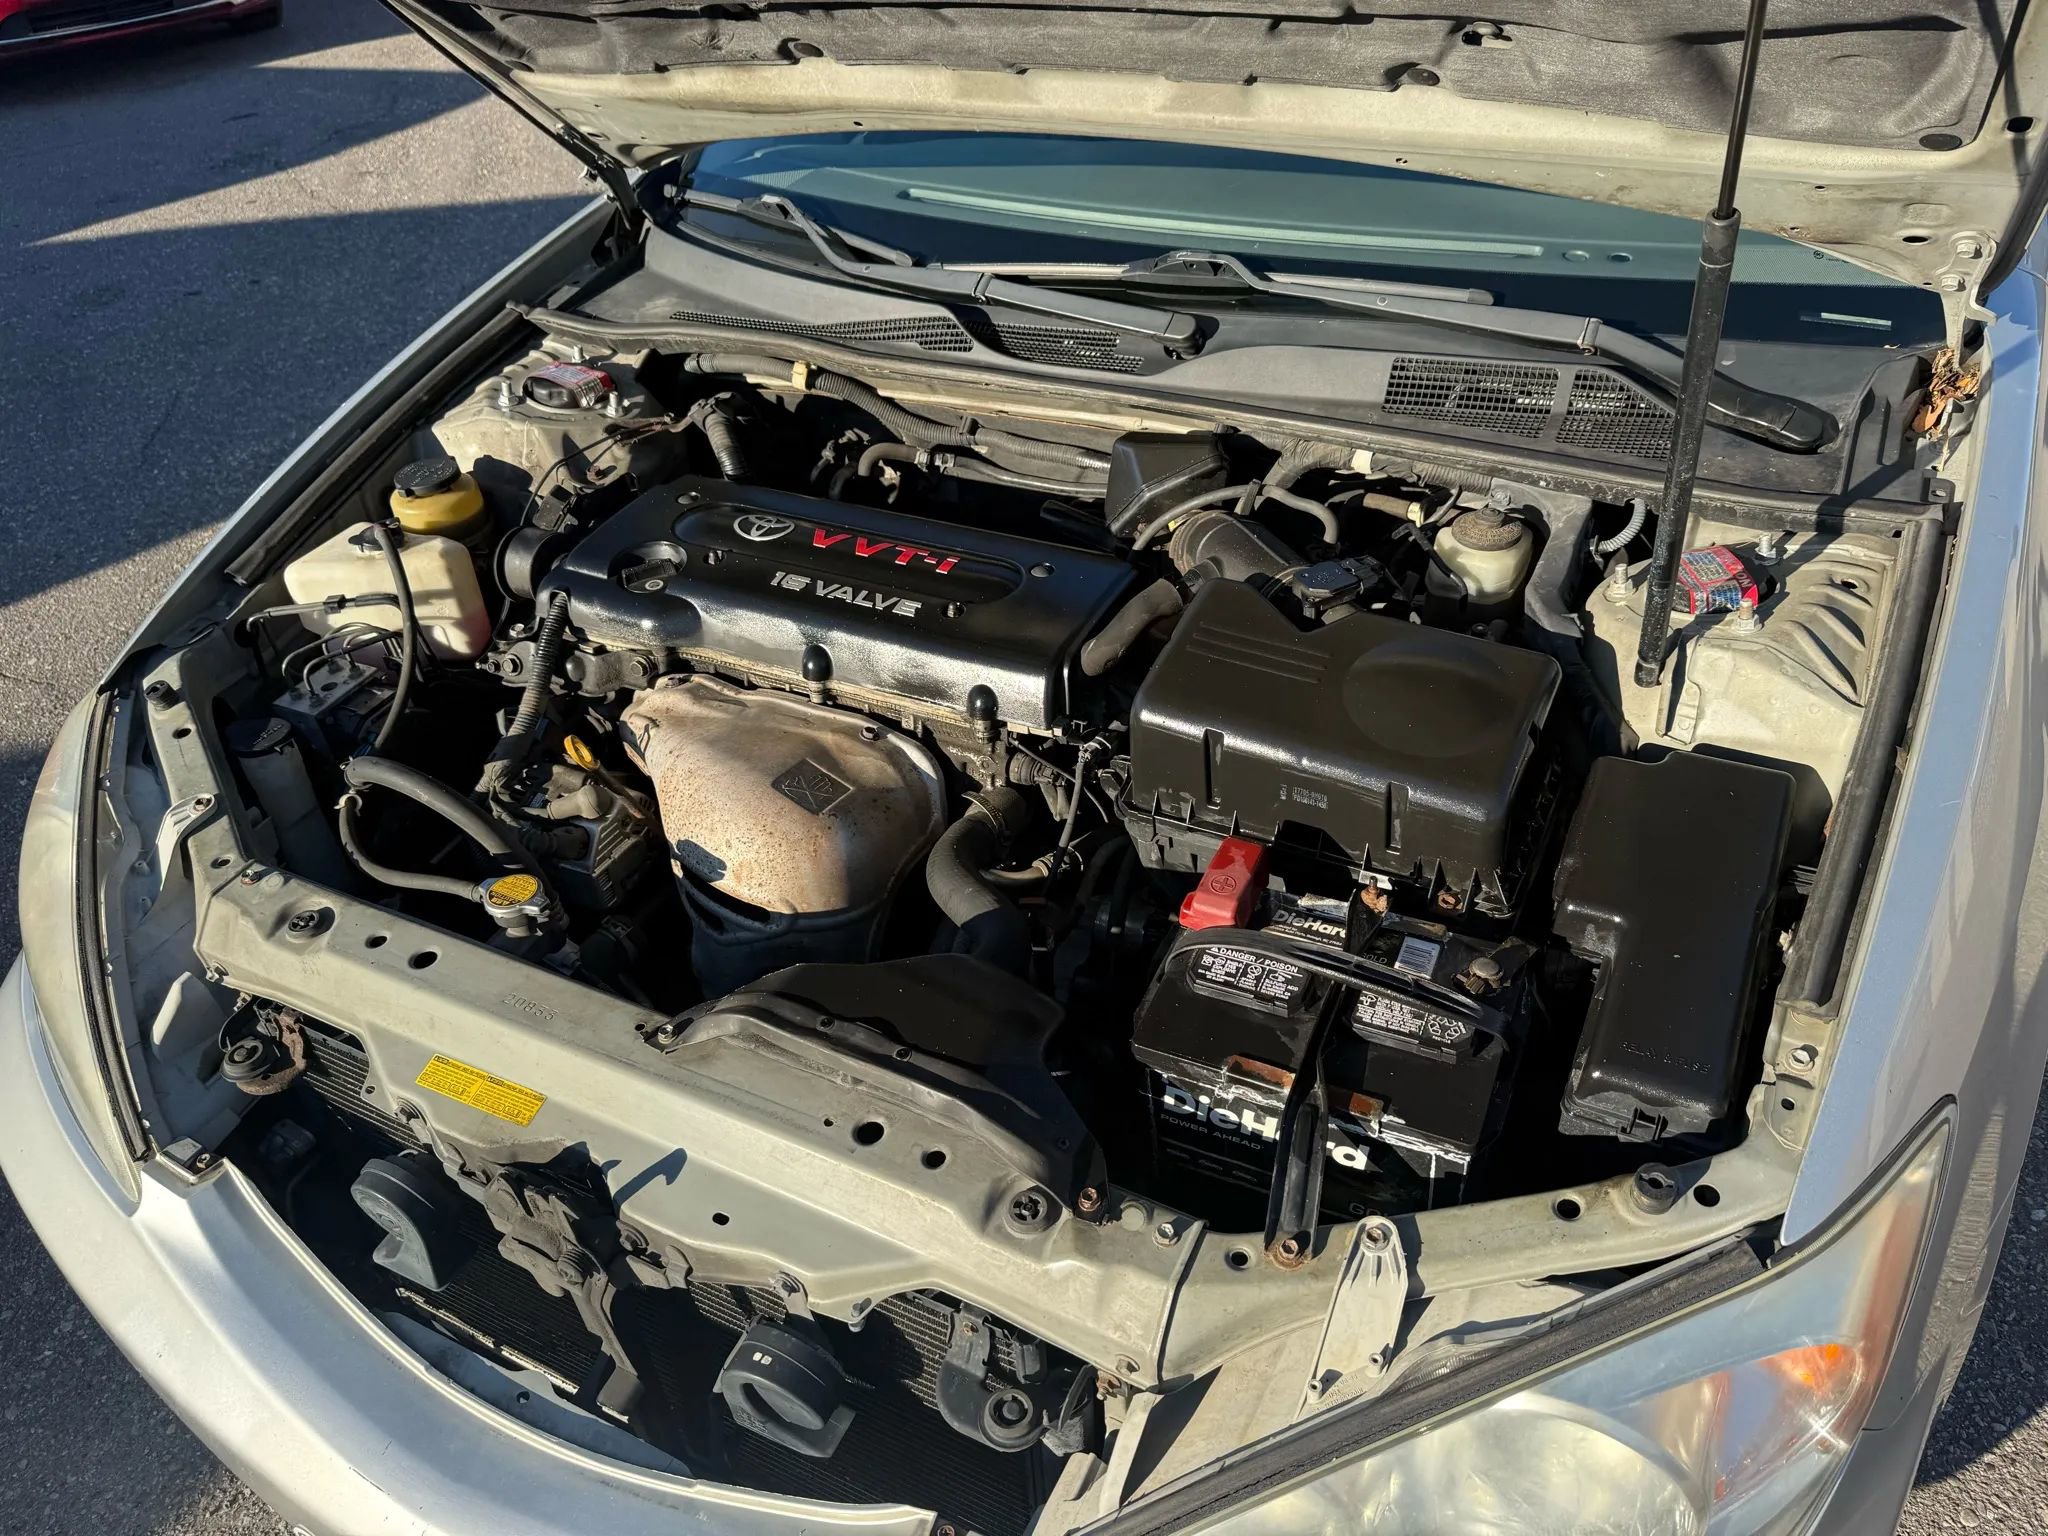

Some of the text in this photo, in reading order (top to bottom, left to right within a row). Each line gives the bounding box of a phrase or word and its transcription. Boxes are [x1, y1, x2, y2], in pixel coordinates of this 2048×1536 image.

[770, 570, 922, 618] 16 VALVE
[1220, 948, 1257, 963] DANGER
[1265, 959, 1299, 973] POISON
[1160, 1113, 1261, 1150] POWER AHEAD
[1163, 1085, 1370, 1171] DieHd
